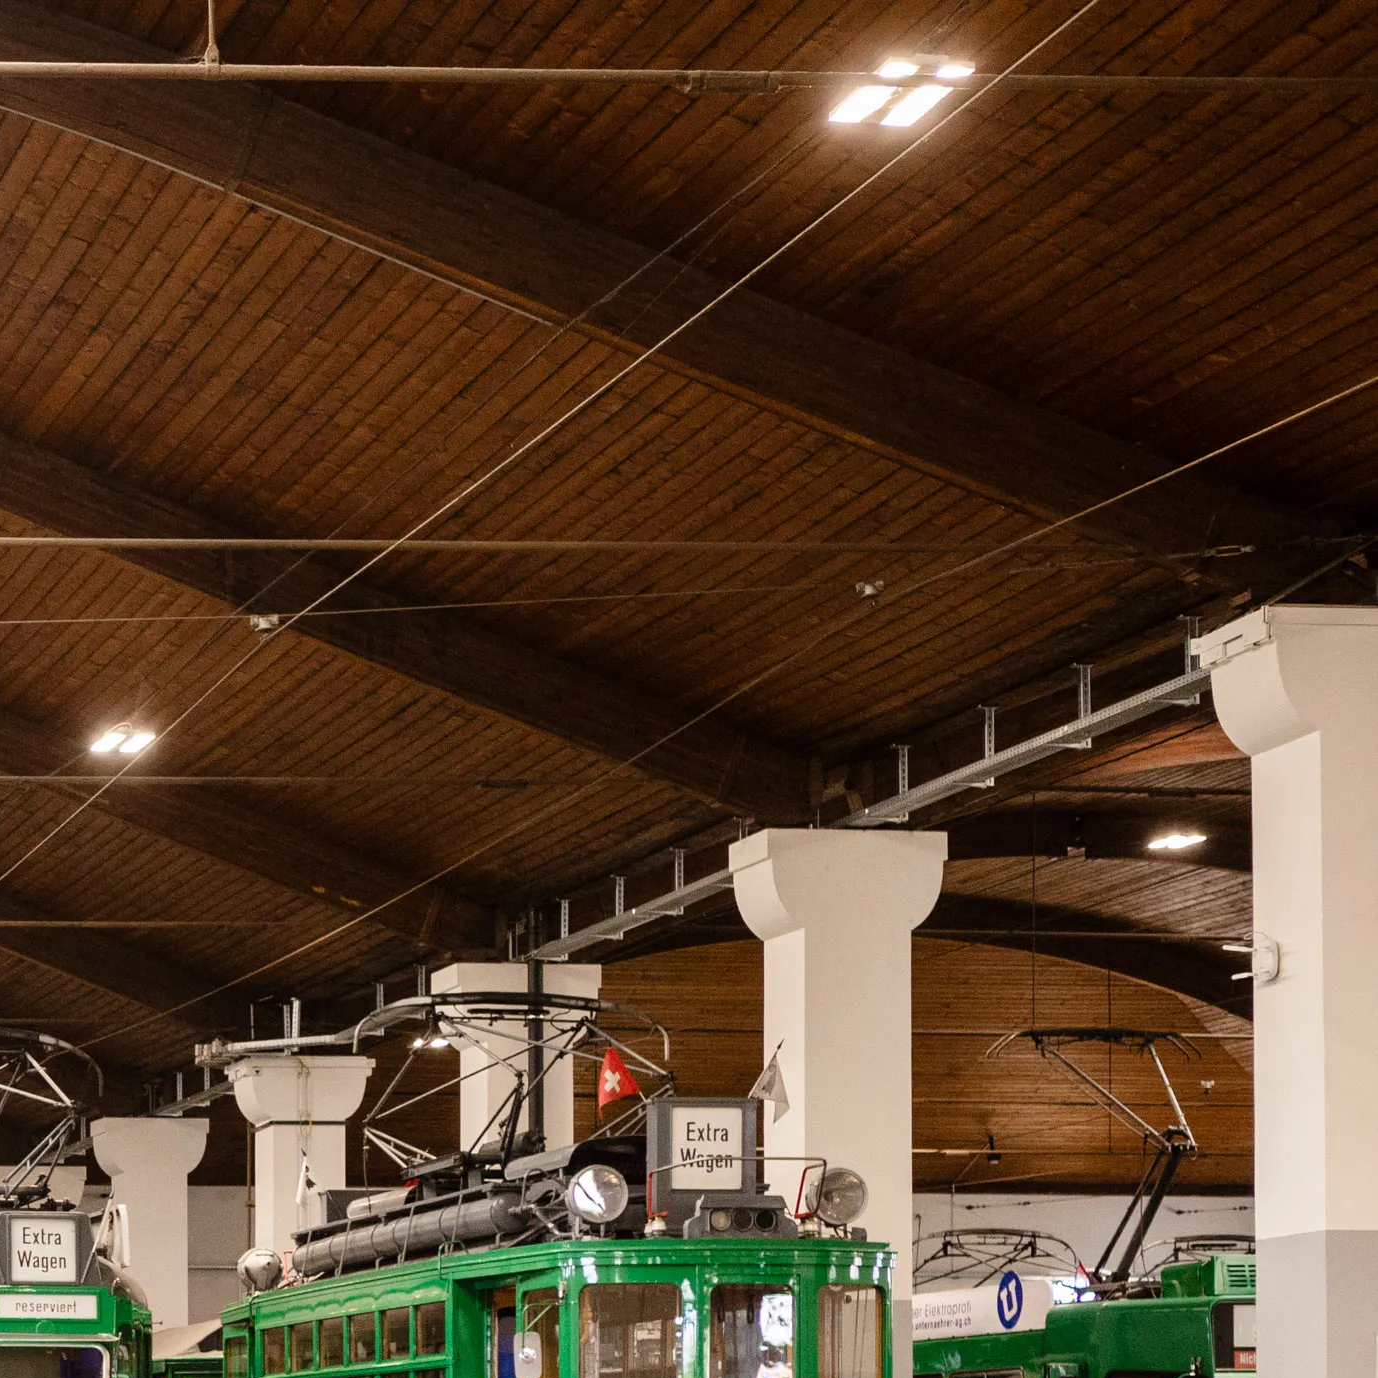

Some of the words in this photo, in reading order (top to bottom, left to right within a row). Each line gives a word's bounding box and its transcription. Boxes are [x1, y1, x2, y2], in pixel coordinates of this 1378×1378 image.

[686, 1121, 728, 1142] Extra
[680, 1147, 733, 1173] Wagen
[22, 1226, 62, 1245] Extra
[17, 1250, 67, 1273] Wagen
[15, 1301, 77, 1313] reserviert
[924, 1300, 972, 1318] Elektroprofi
